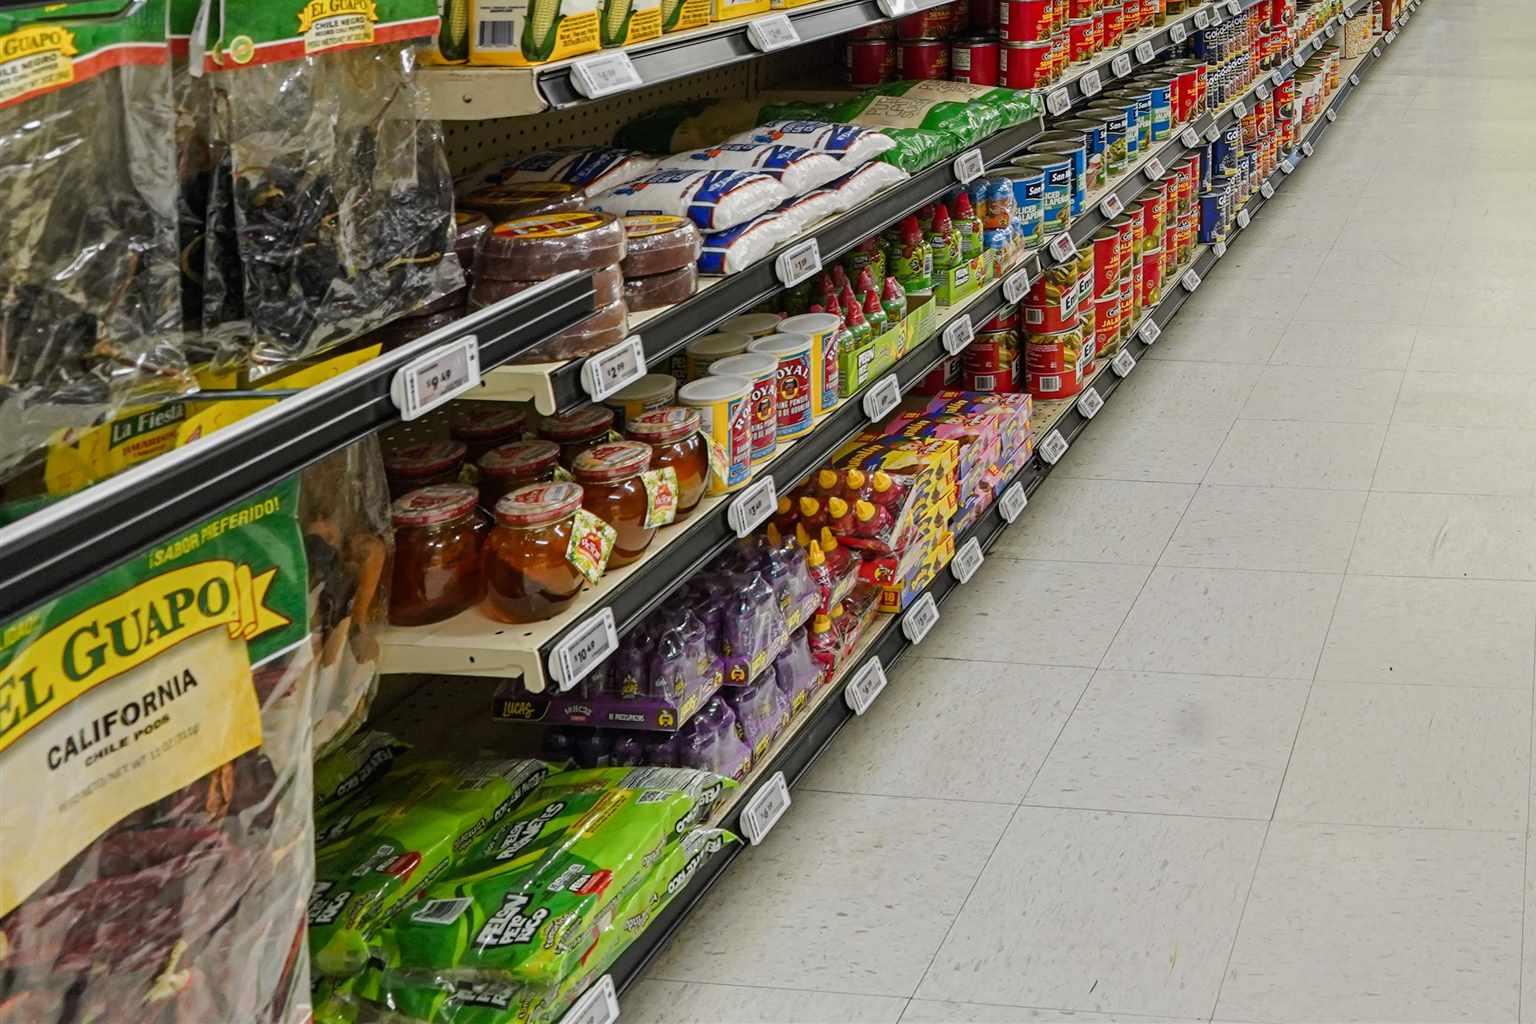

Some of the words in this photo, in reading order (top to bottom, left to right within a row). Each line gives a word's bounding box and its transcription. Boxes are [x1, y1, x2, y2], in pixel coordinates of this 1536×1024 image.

[311, 2, 325, 16] EL
[1052, 170, 1068, 182] San
[1028, 184, 1042, 196] San
[112, 423, 132, 444] La
[137, 403, 185, 433] Fiesta
[0, 666, 54, 738] EL
[62, 576, 231, 683] GUAPO
[47, 668, 198, 771] CALIFORNIA
[502, 701, 536, 718] LUCAS
[85, 736, 128, 767] CHILE
